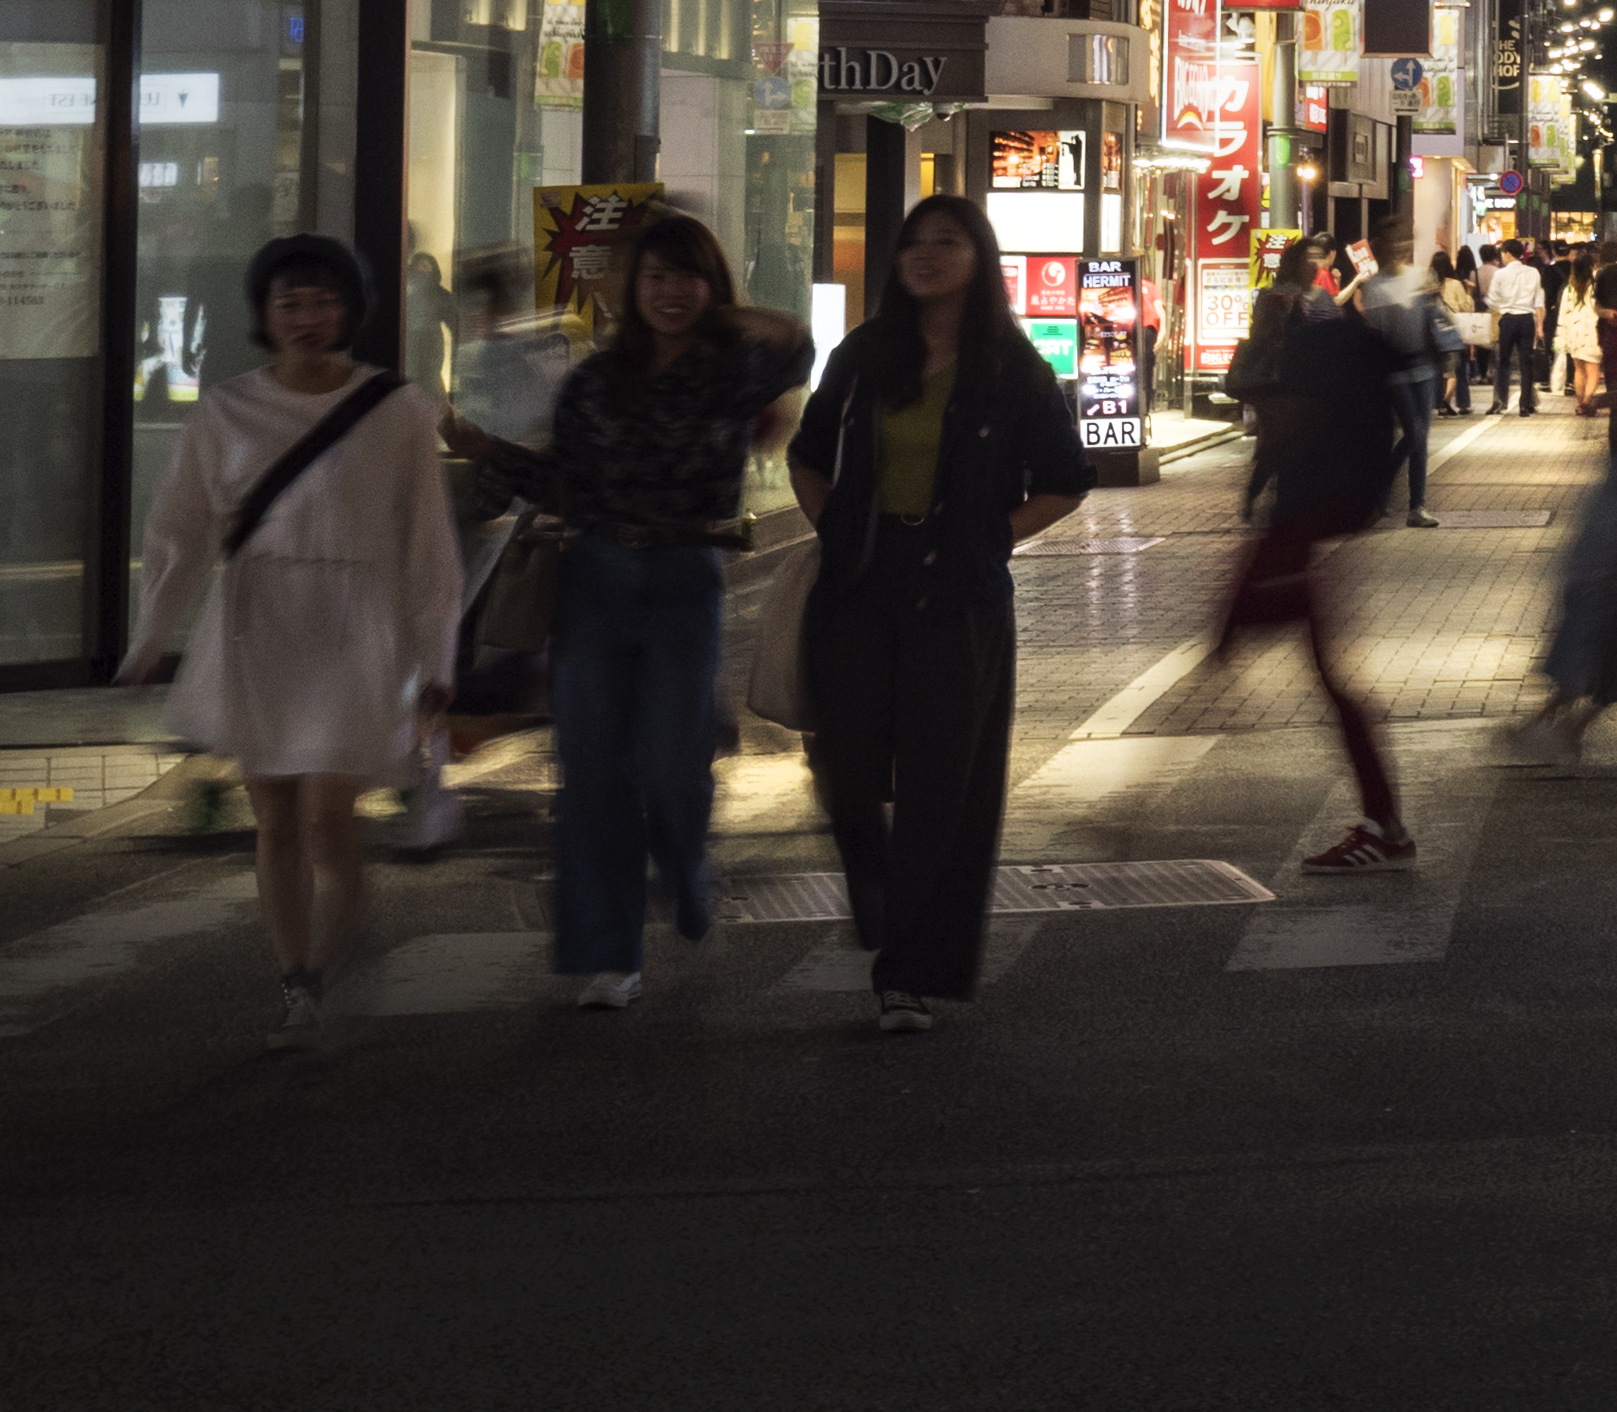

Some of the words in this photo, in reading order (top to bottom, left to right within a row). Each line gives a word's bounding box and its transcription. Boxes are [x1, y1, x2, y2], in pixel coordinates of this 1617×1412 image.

[1206, 74, 1250, 246] カラオケ
[1088, 261, 1122, 273] BAR
[1083, 275, 1131, 288] HERMIT
[1205, 311, 1250, 326] OFF
[1103, 400, 1128, 414] B1
[1086, 420, 1136, 446] BAR
